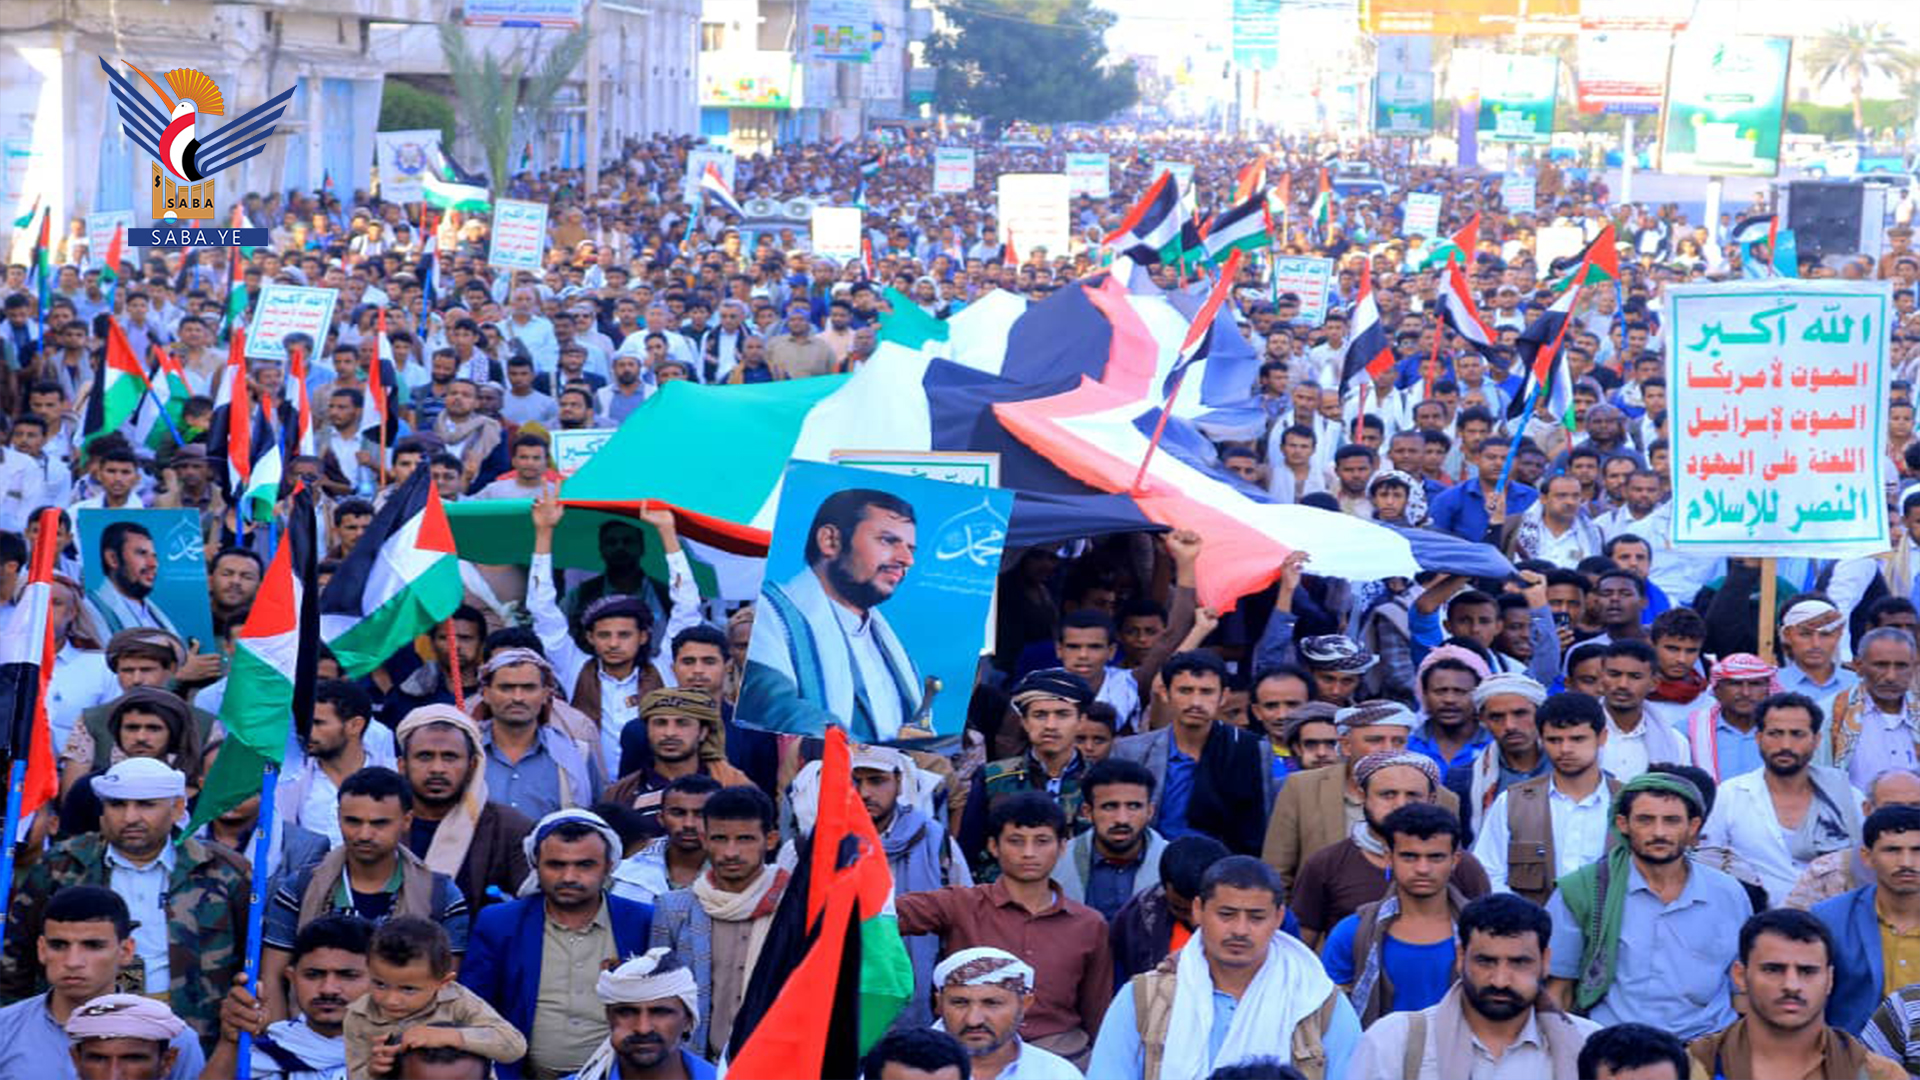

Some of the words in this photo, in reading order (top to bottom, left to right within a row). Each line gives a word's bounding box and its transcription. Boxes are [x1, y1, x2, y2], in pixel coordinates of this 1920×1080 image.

[1686, 298, 1798, 358] أكبر
[1802, 303, 1872, 344] الله
[1687, 356, 1784, 395] لأمريكا
[1791, 361, 1868, 394] الموت
[1687, 402, 1784, 440] لإسرائيل
[1790, 404, 1866, 438] الموت
[1686, 448, 1754, 481] اليهود
[1762, 449, 1798, 482] على
[1808, 447, 1865, 474] اللعنة
[1687, 487, 1779, 538] للإسلام
[1786, 483, 1868, 534] النصر
